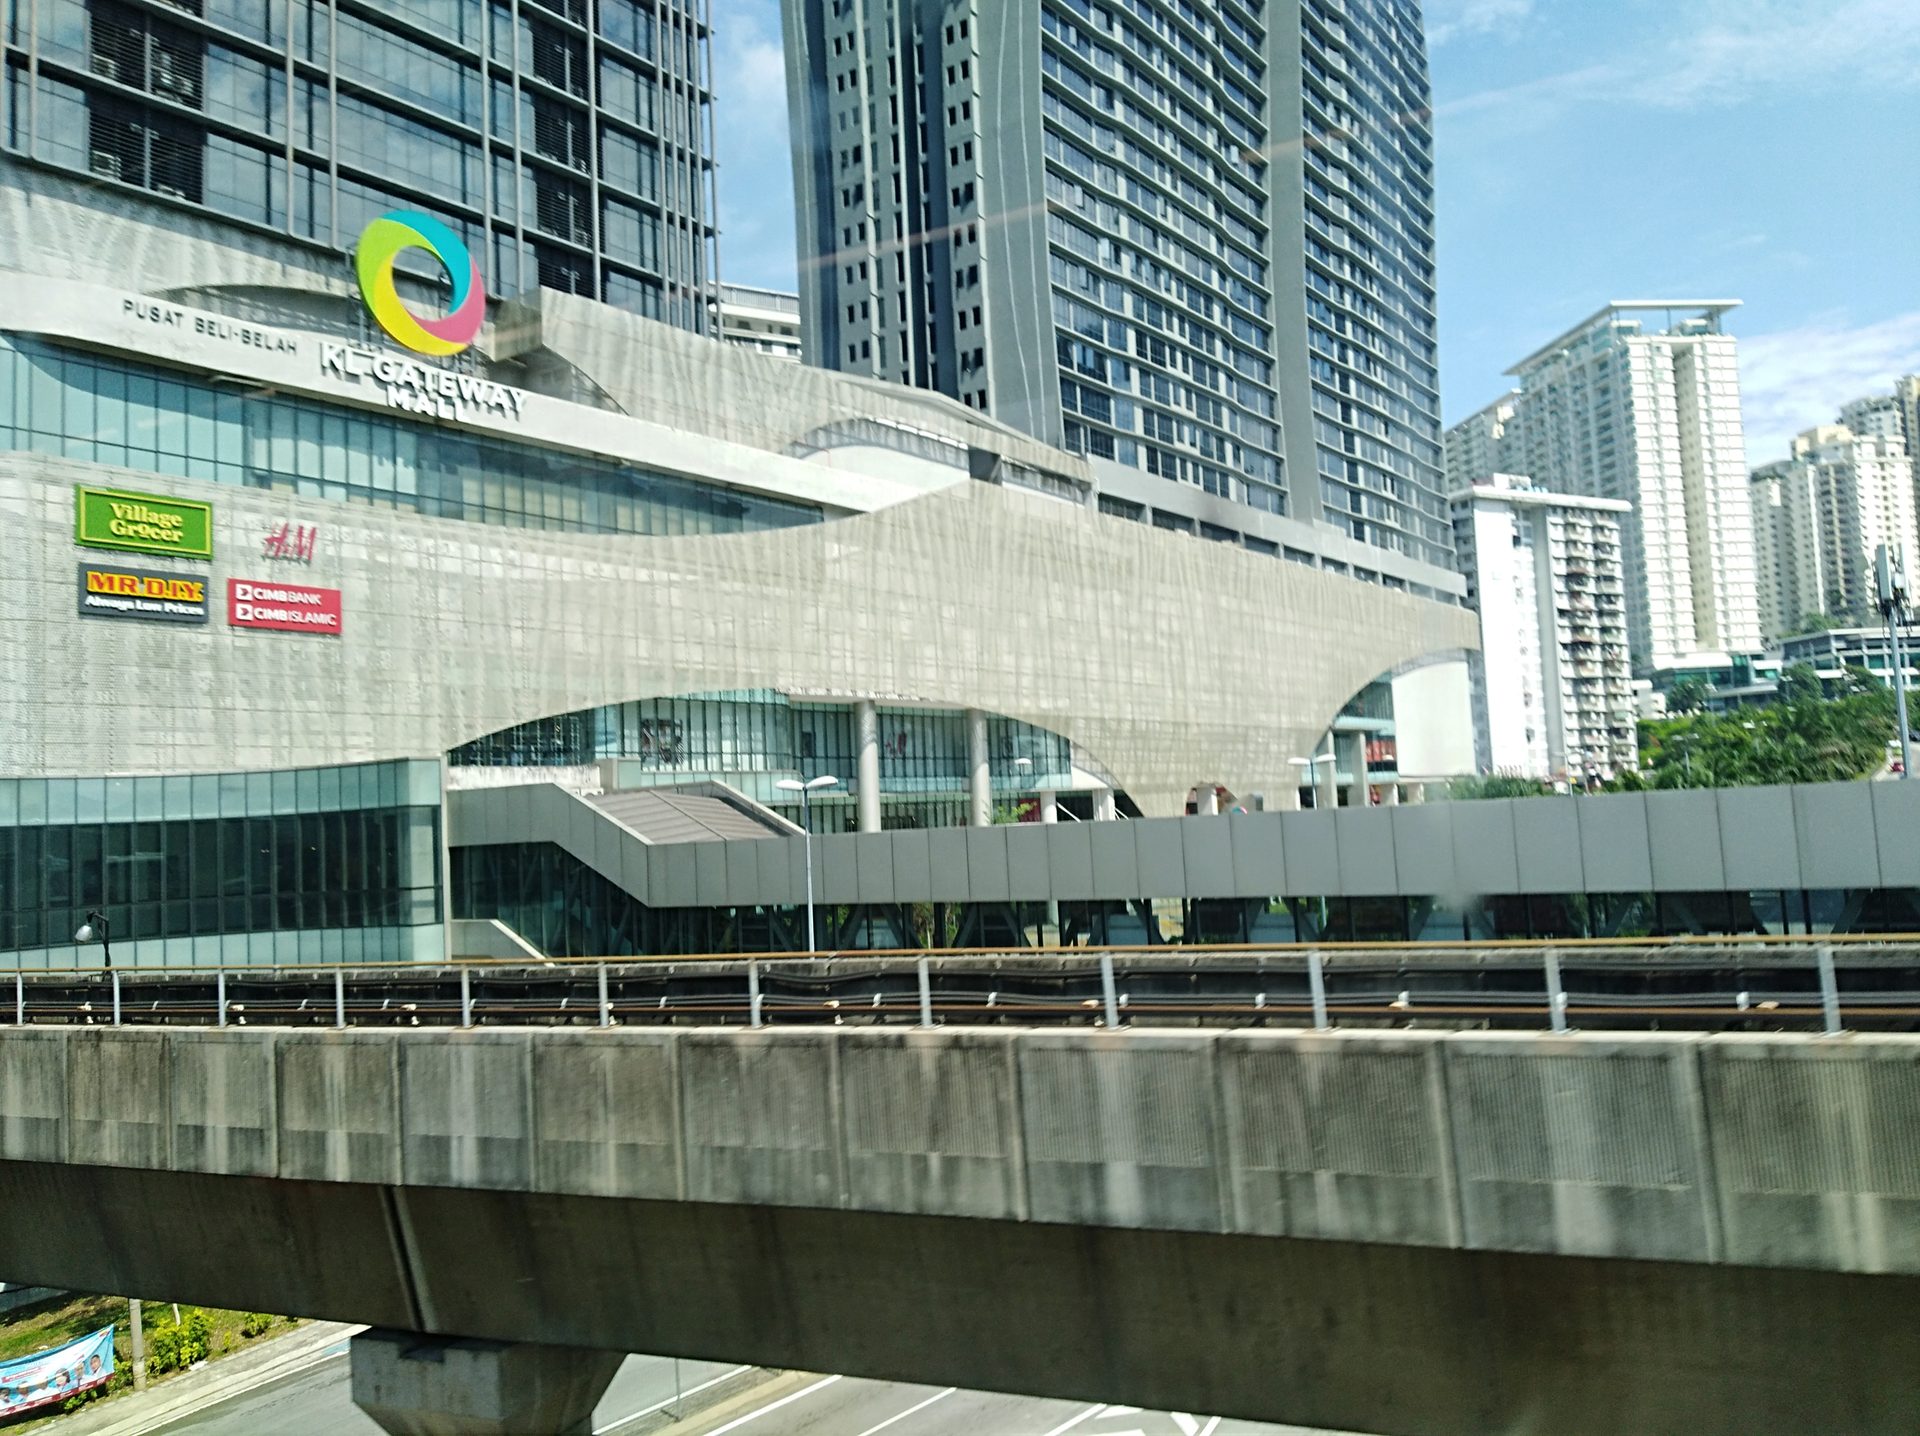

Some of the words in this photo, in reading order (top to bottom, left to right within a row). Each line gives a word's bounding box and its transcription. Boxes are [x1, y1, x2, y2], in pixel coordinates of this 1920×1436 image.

[123, 299, 184, 327] PUSAT
[195, 317, 297, 354] BELI-BELAH
[320, 342, 363, 377] KL
[372, 356, 526, 413] GATEWAY
[386, 384, 471, 422] MALL
[109, 502, 183, 528] Village
[109, 519, 183, 543] Grocer
[263, 521, 317, 561] H&M
[85, 595, 135, 611] Always
[136, 600, 162, 612] Low
[164, 602, 205, 616] Prices
